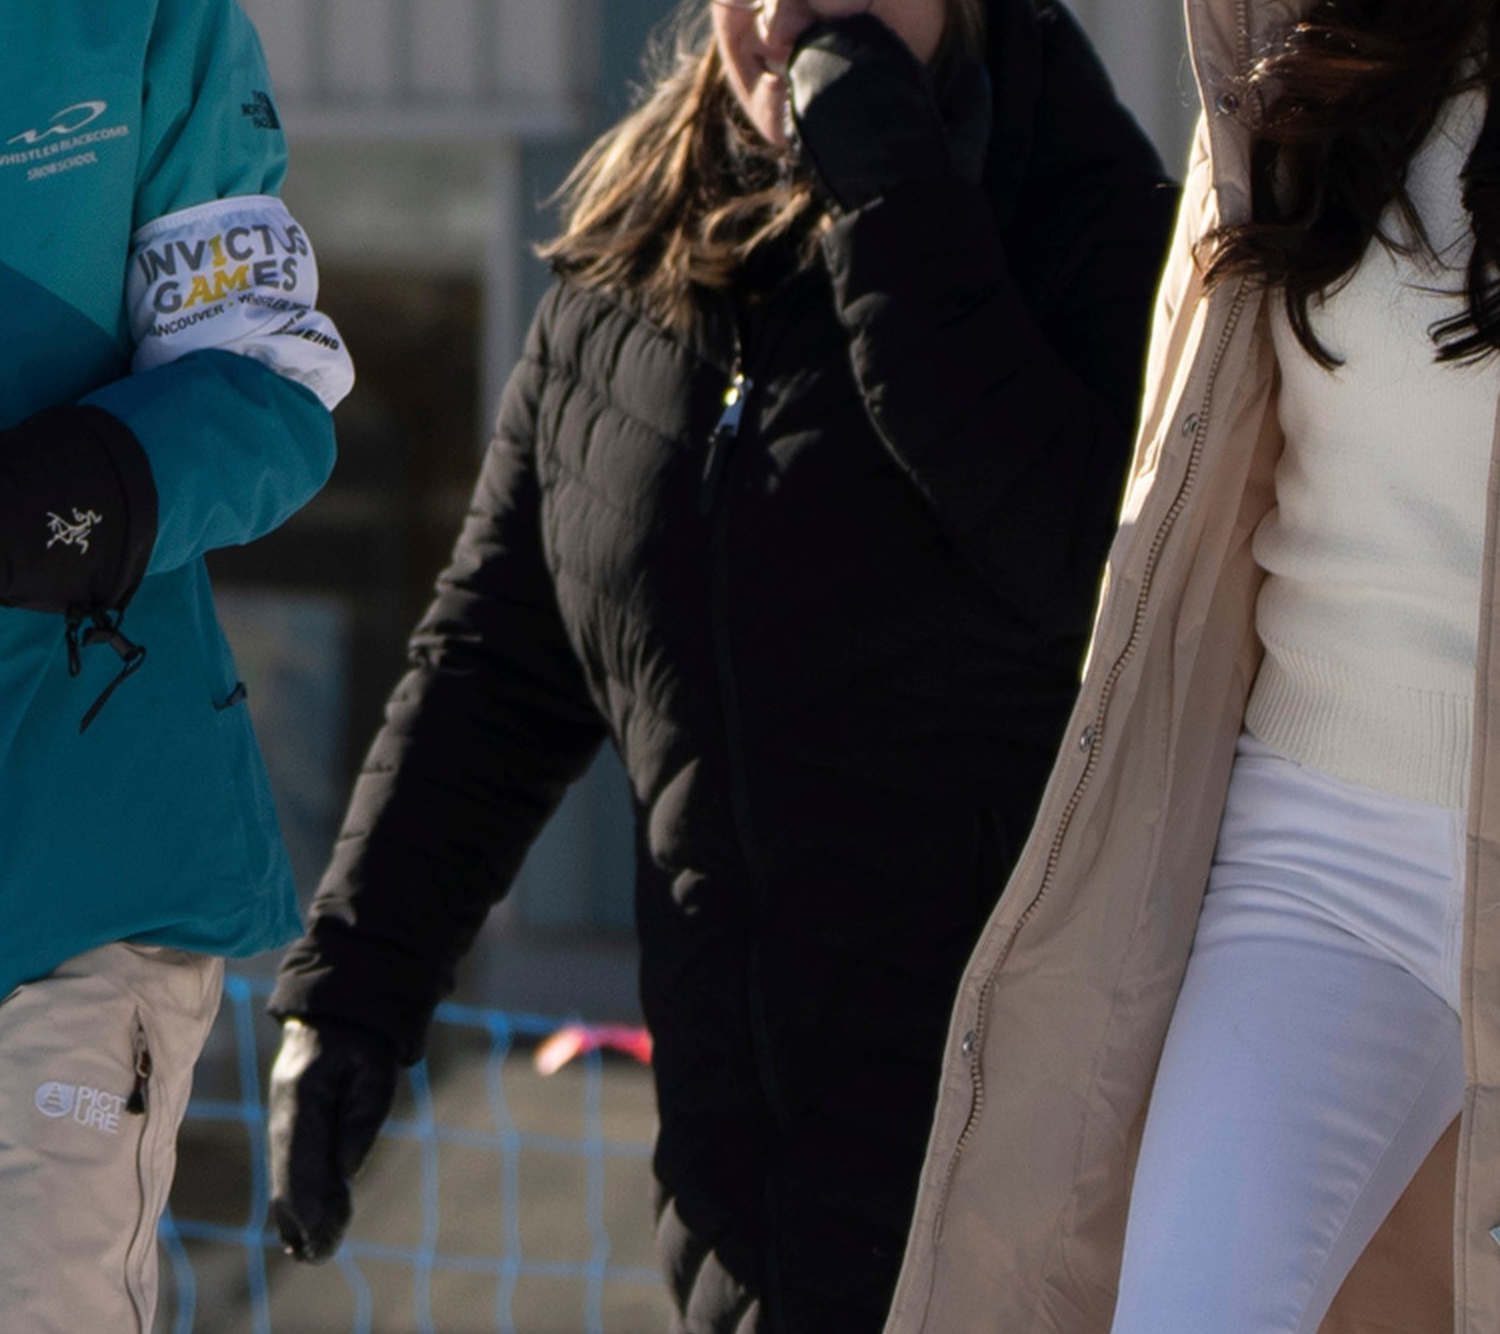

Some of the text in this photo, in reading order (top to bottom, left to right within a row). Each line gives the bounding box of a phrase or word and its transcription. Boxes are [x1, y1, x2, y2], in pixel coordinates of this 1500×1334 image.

[59, 124, 130, 152] BLACKCOMB
[137, 224, 308, 286] INVICTUS
[153, 256, 298, 315] GAMES
[150, 304, 225, 338] ANCOUVER
[77, 1085, 127, 1115] PICT
[73, 1104, 119, 1135] URE
